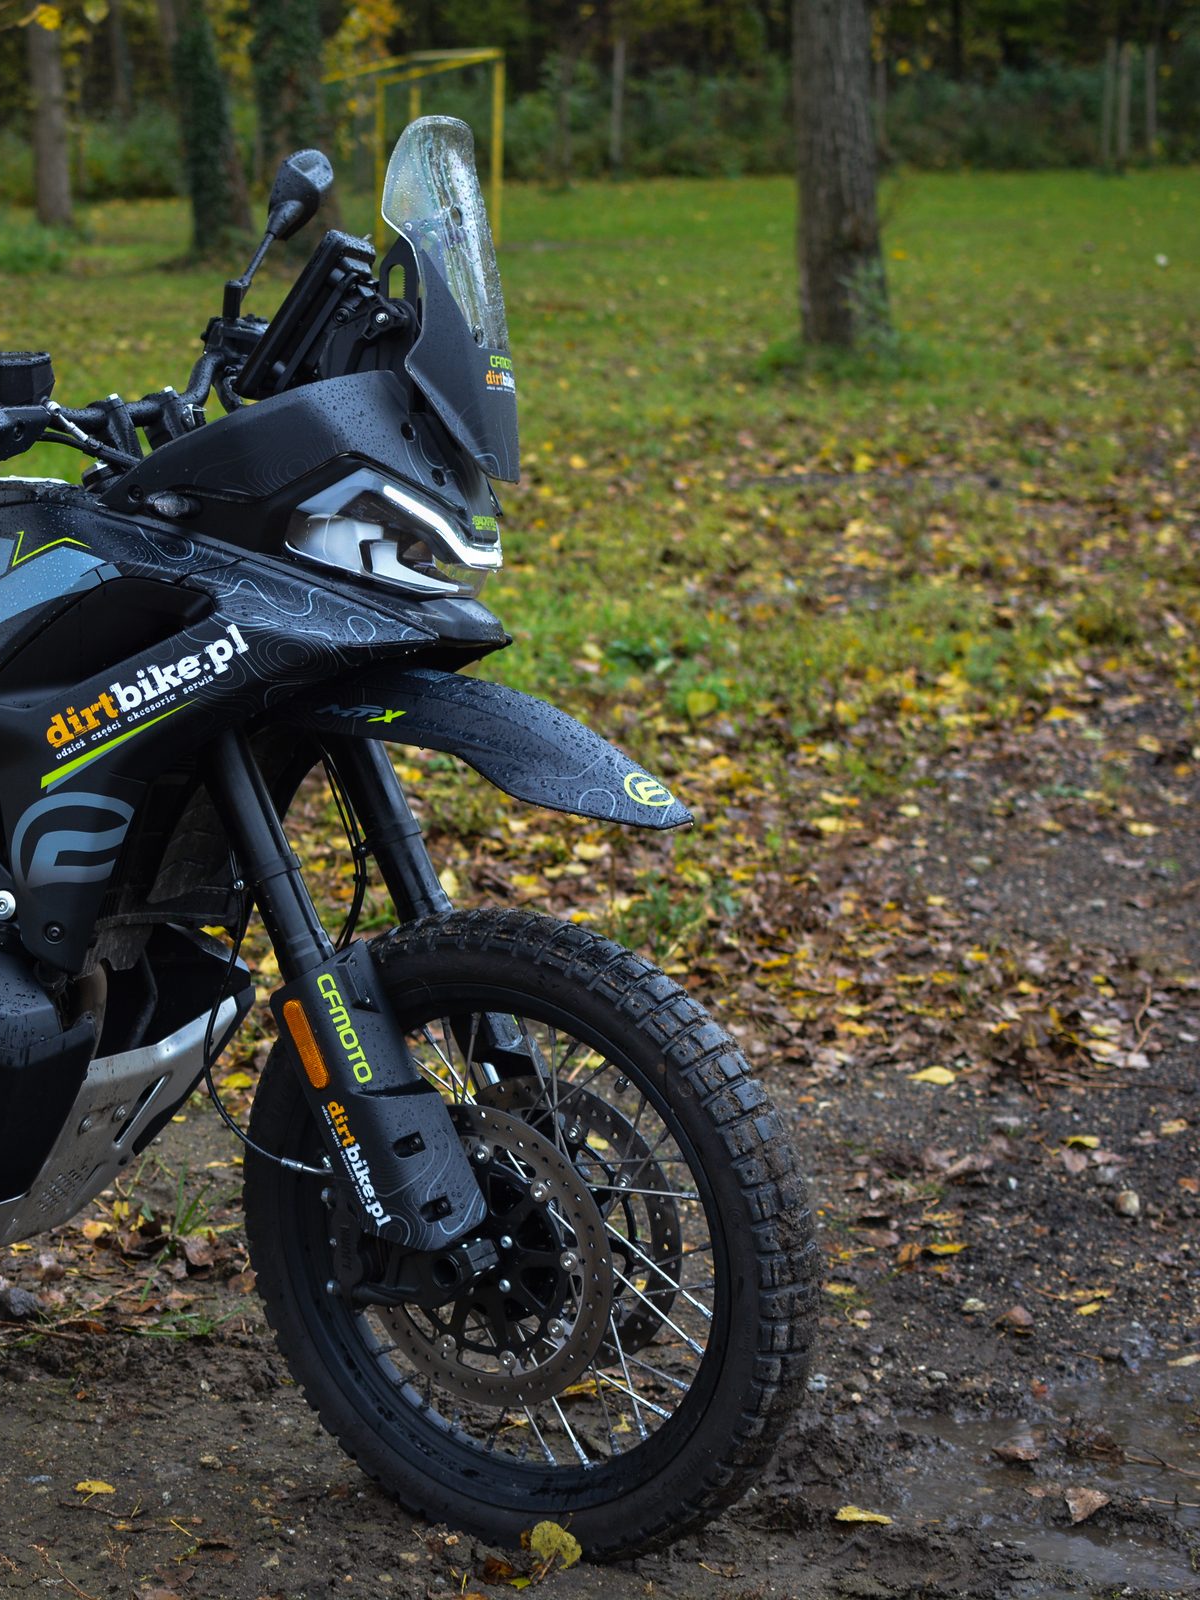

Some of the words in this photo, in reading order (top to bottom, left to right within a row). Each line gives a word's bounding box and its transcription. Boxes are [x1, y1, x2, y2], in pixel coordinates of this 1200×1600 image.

[46, 623, 250, 749] dirtbike.pl
[90, 719, 122, 742] części
[126, 694, 176, 722] akcesoria
[182, 674, 214, 695] serwis
[317, 973, 373, 1084] CFMOTO
[327, 1101, 392, 1227] dirtbike.pl
